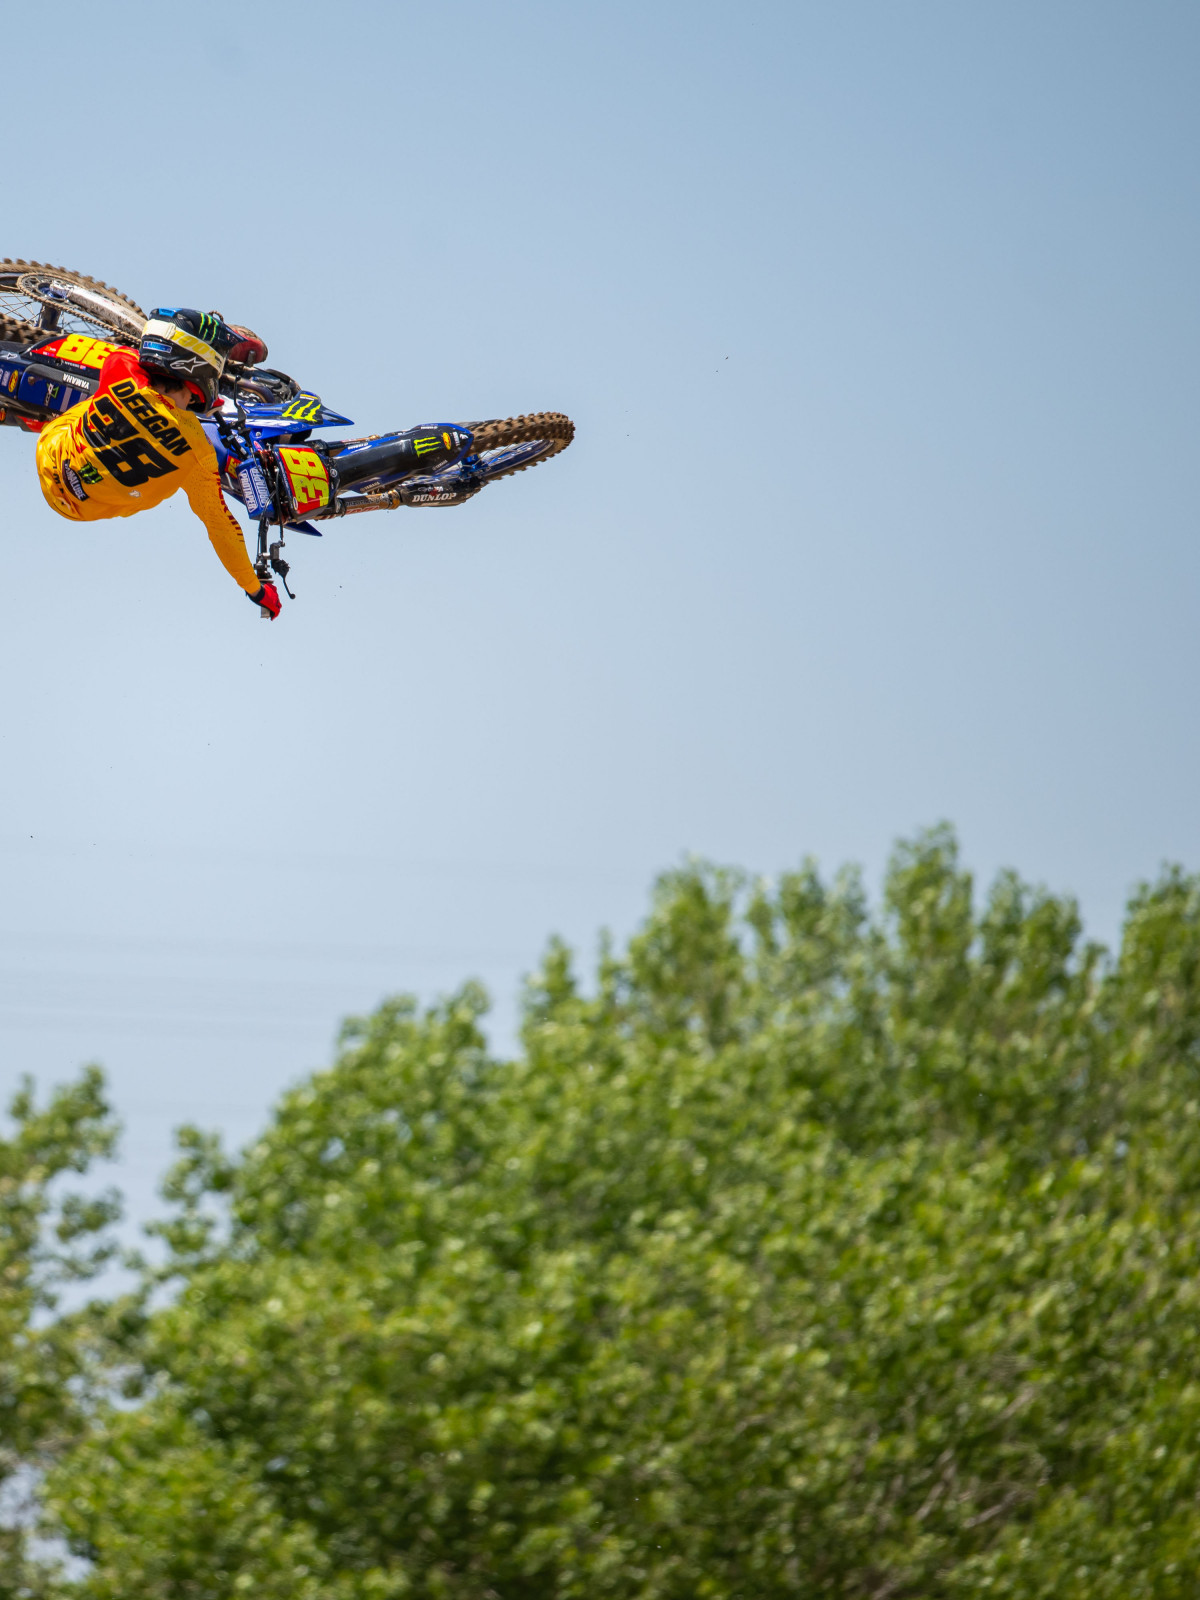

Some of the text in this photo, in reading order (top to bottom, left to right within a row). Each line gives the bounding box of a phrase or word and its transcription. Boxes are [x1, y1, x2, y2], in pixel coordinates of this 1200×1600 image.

[56, 334, 118, 369] 38
[63, 373, 90, 390] YAMAHA
[111, 380, 192, 456] DEEGAN
[83, 397, 179, 487] 38
[241, 471, 258, 513] PROTAPER
[279, 447, 329, 507] 38
[412, 492, 457, 503] DUNLOP
